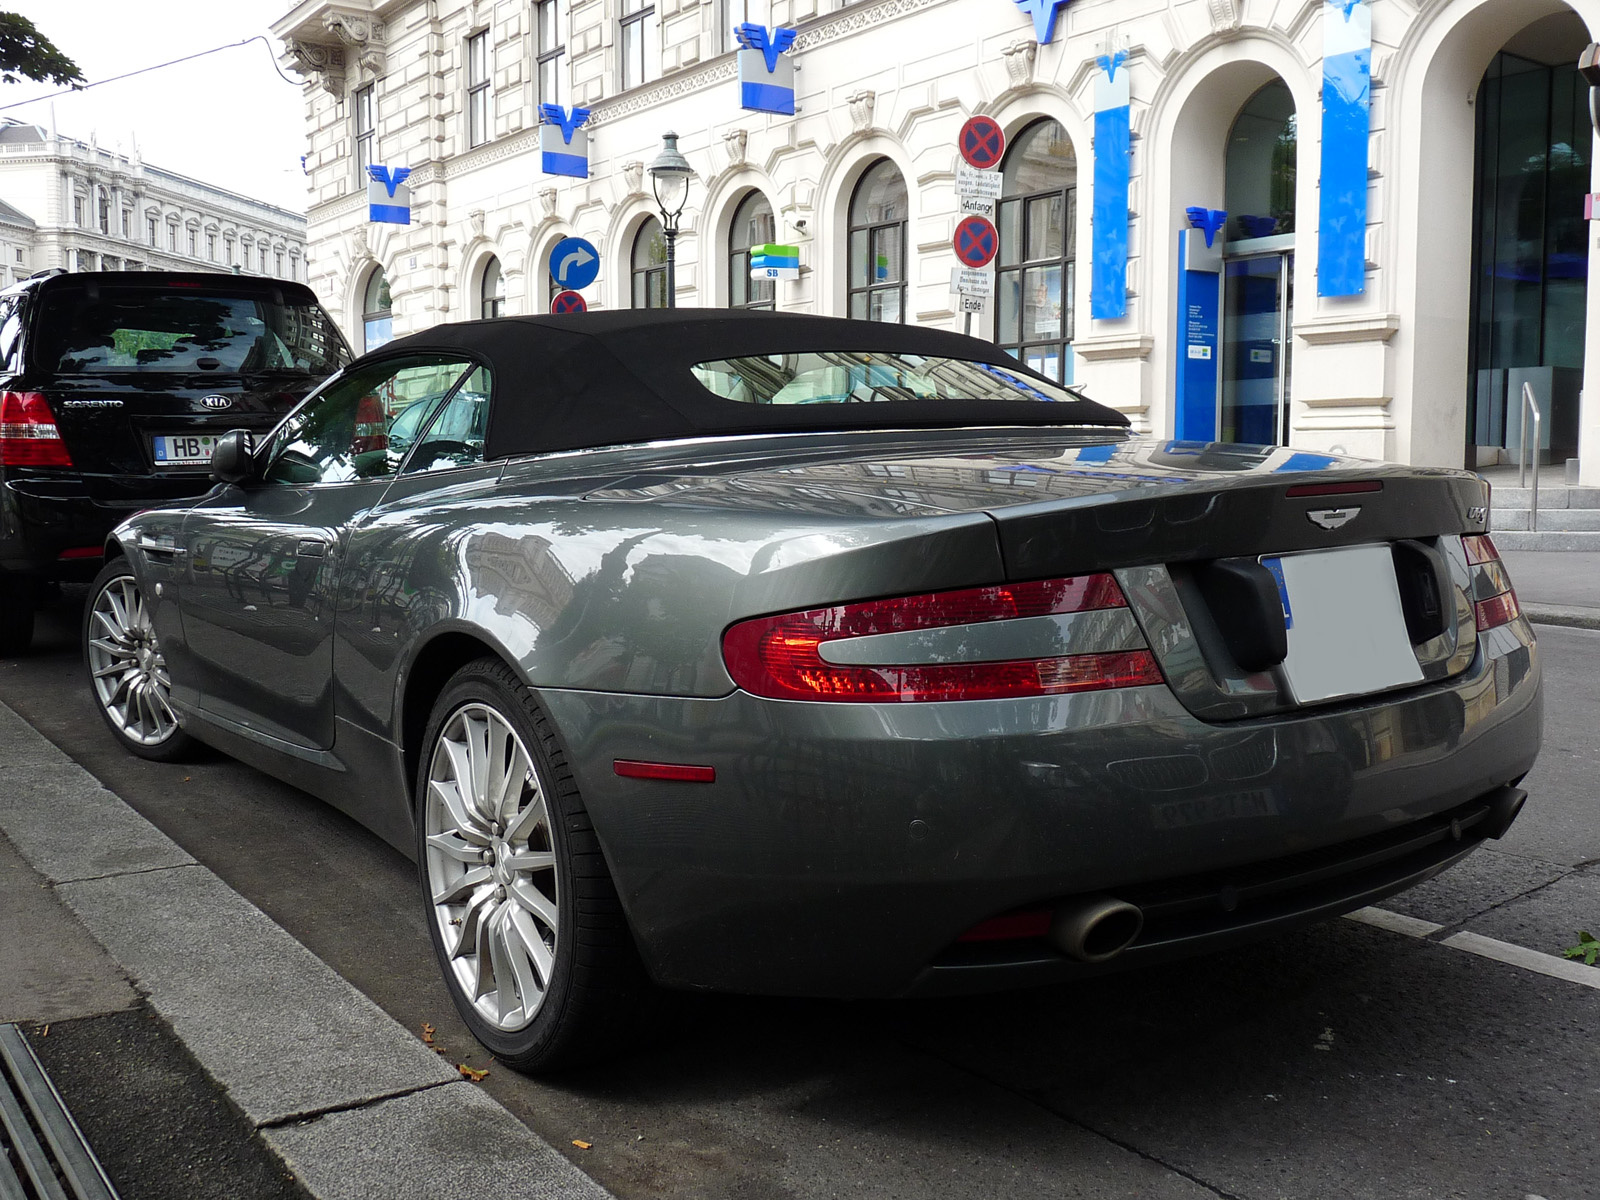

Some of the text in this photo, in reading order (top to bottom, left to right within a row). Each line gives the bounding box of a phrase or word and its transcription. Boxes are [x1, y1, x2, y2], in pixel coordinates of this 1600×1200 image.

[964, 200, 991, 214] Anfang
[766, 268, 779, 277] SB
[964, 298, 982, 310] Ende
[63, 399, 124, 409] SORENTO
[204, 397, 227, 407] KIA
[172, 437, 200, 457] HB
